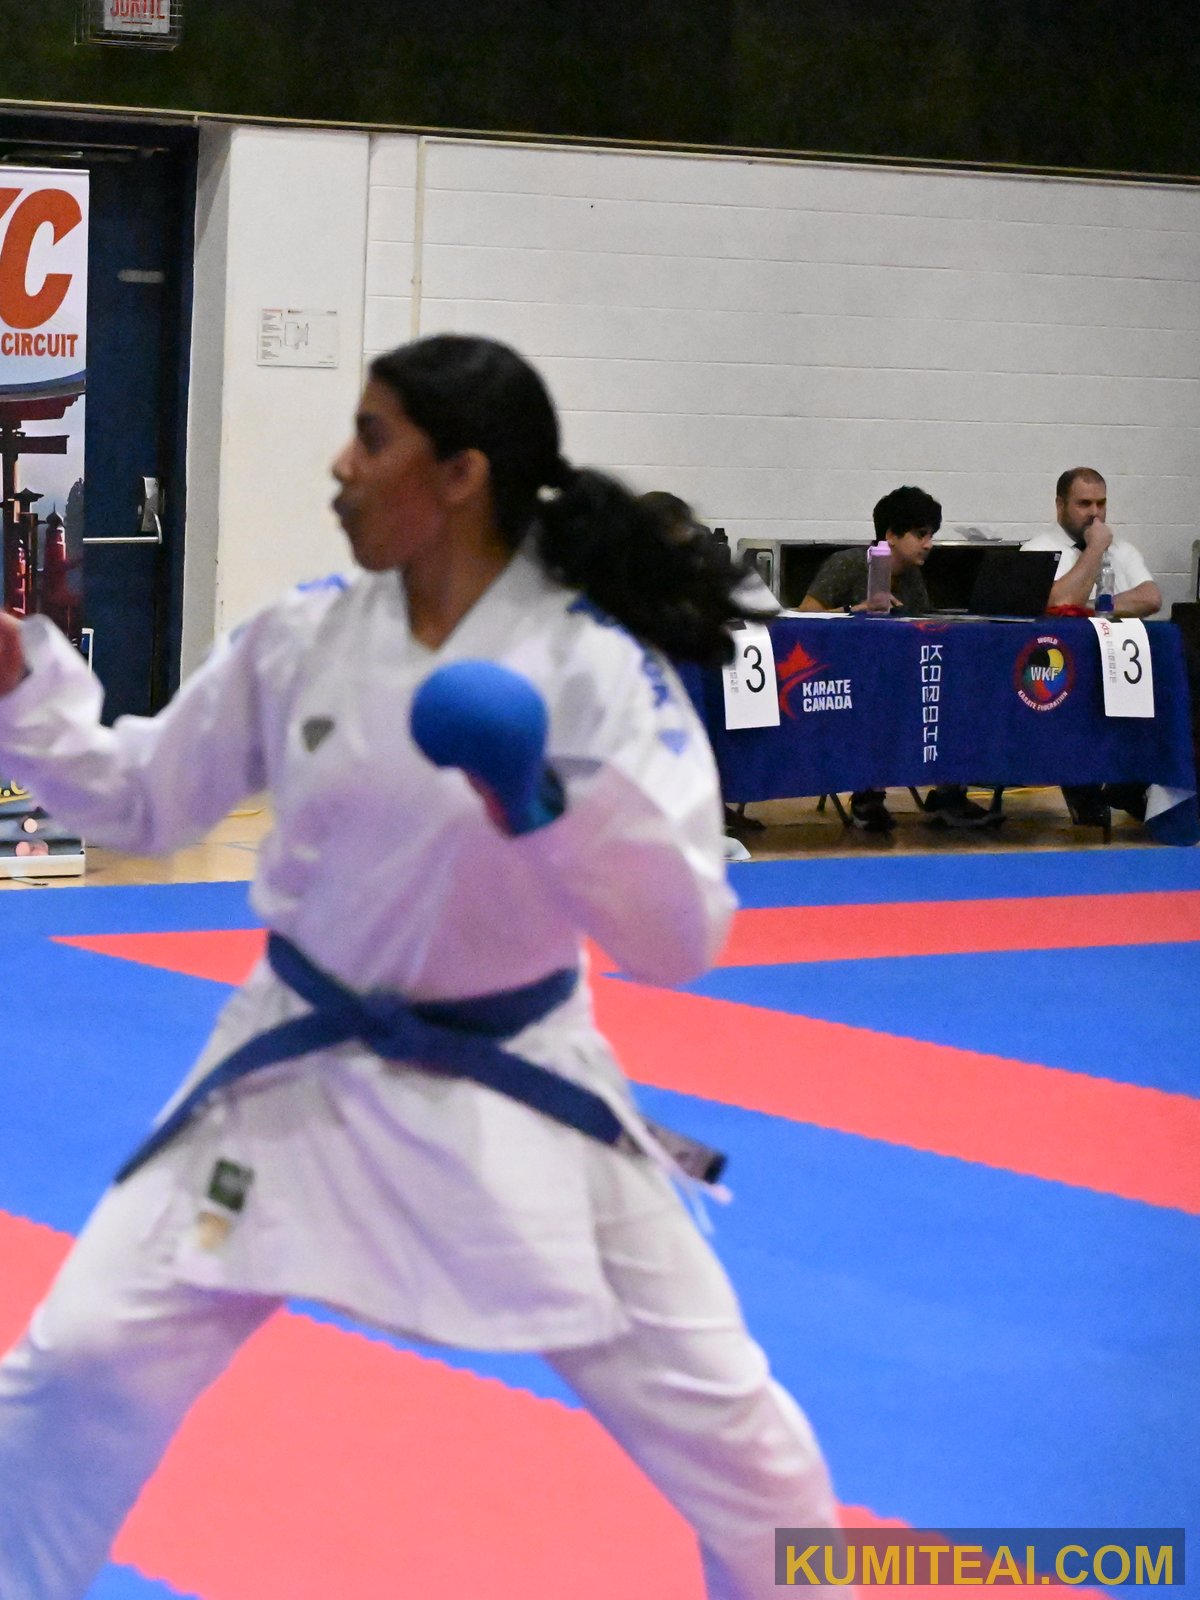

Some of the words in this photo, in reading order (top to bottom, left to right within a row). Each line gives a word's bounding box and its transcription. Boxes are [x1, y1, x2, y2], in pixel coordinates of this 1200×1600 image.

[1, 333, 79, 357] CIRCUIT
[743, 644, 766, 693] 3
[1122, 638, 1143, 685] 3
[1030, 666, 1060, 681] WKF
[802, 679, 852, 697] KARATE
[803, 695, 853, 713] CANADA
